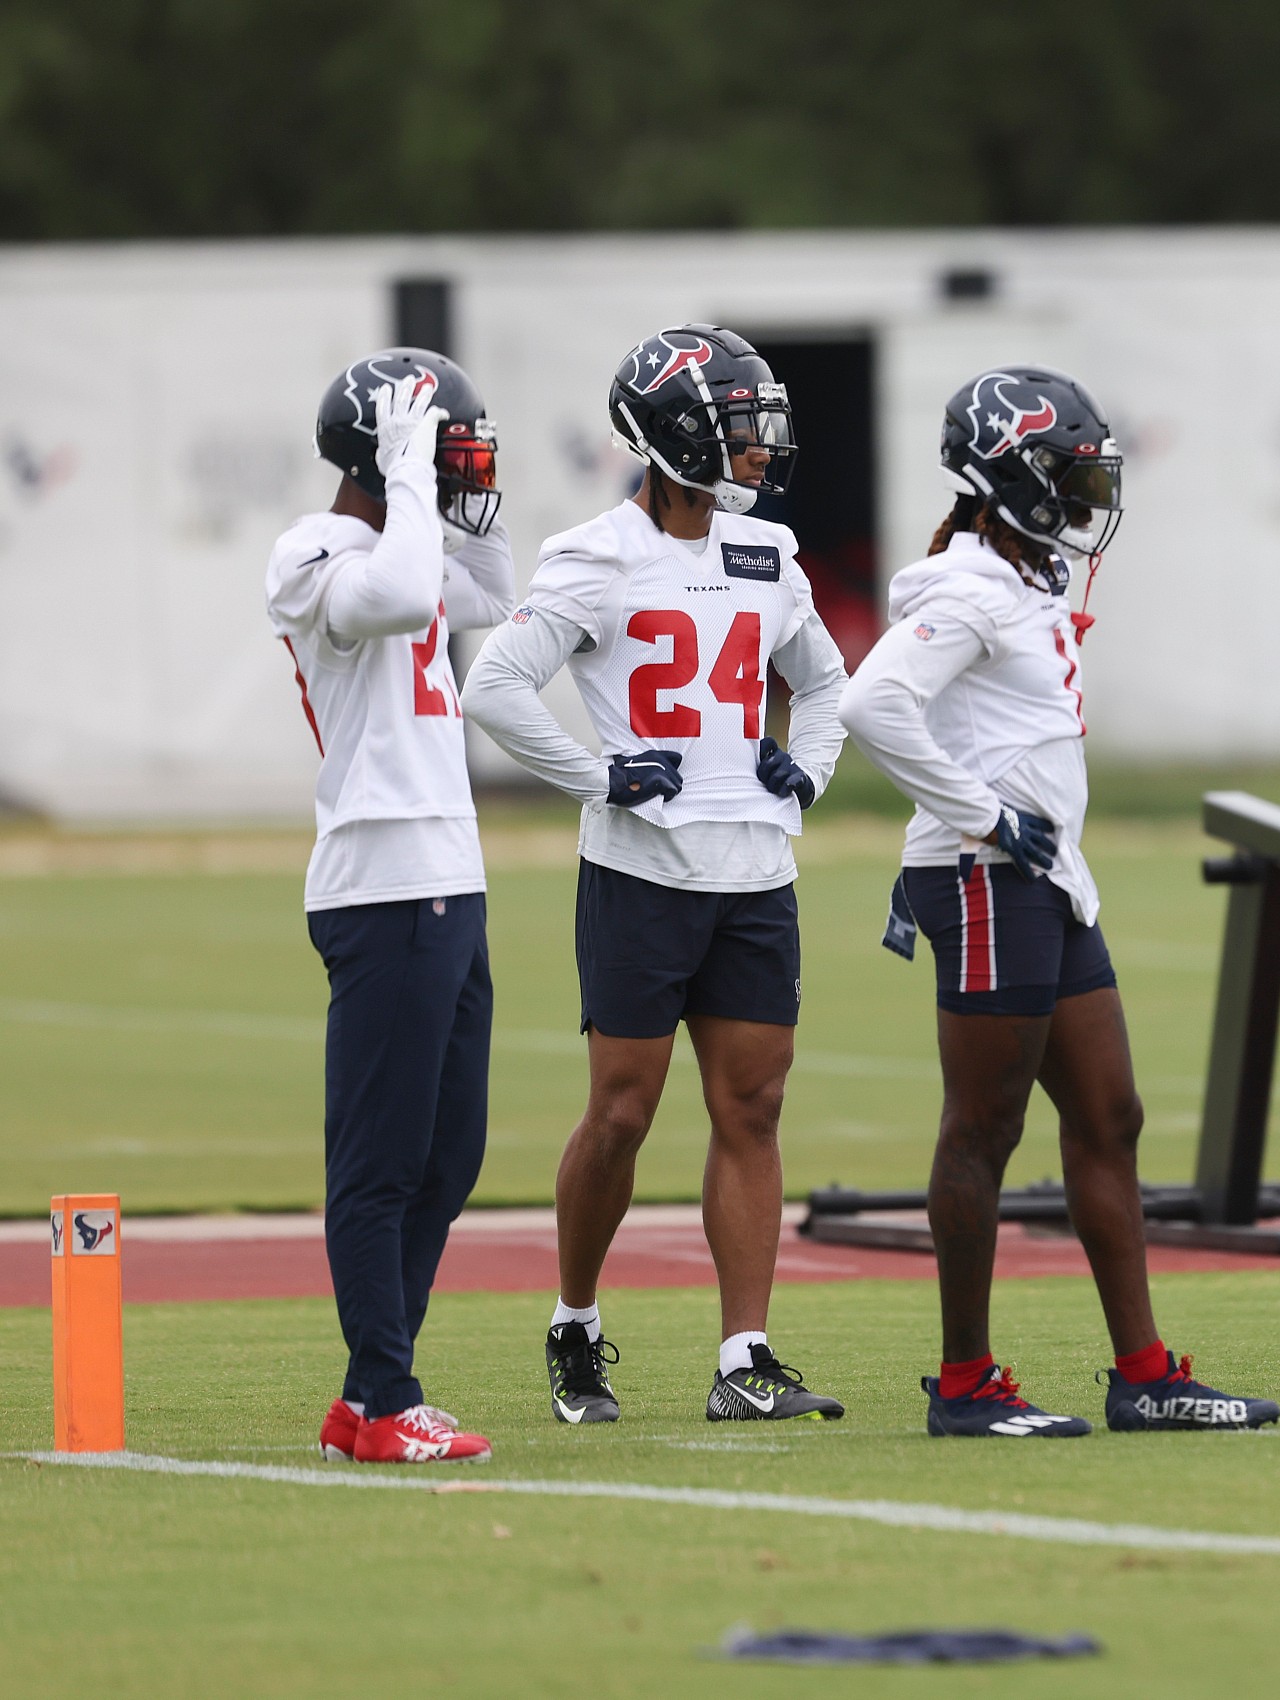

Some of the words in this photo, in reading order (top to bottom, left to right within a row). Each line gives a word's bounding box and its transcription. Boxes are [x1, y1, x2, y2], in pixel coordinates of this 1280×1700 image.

[729, 555, 775, 568] Methodist
[684, 585, 731, 593] TEXANS
[626, 609, 765, 740] 24
